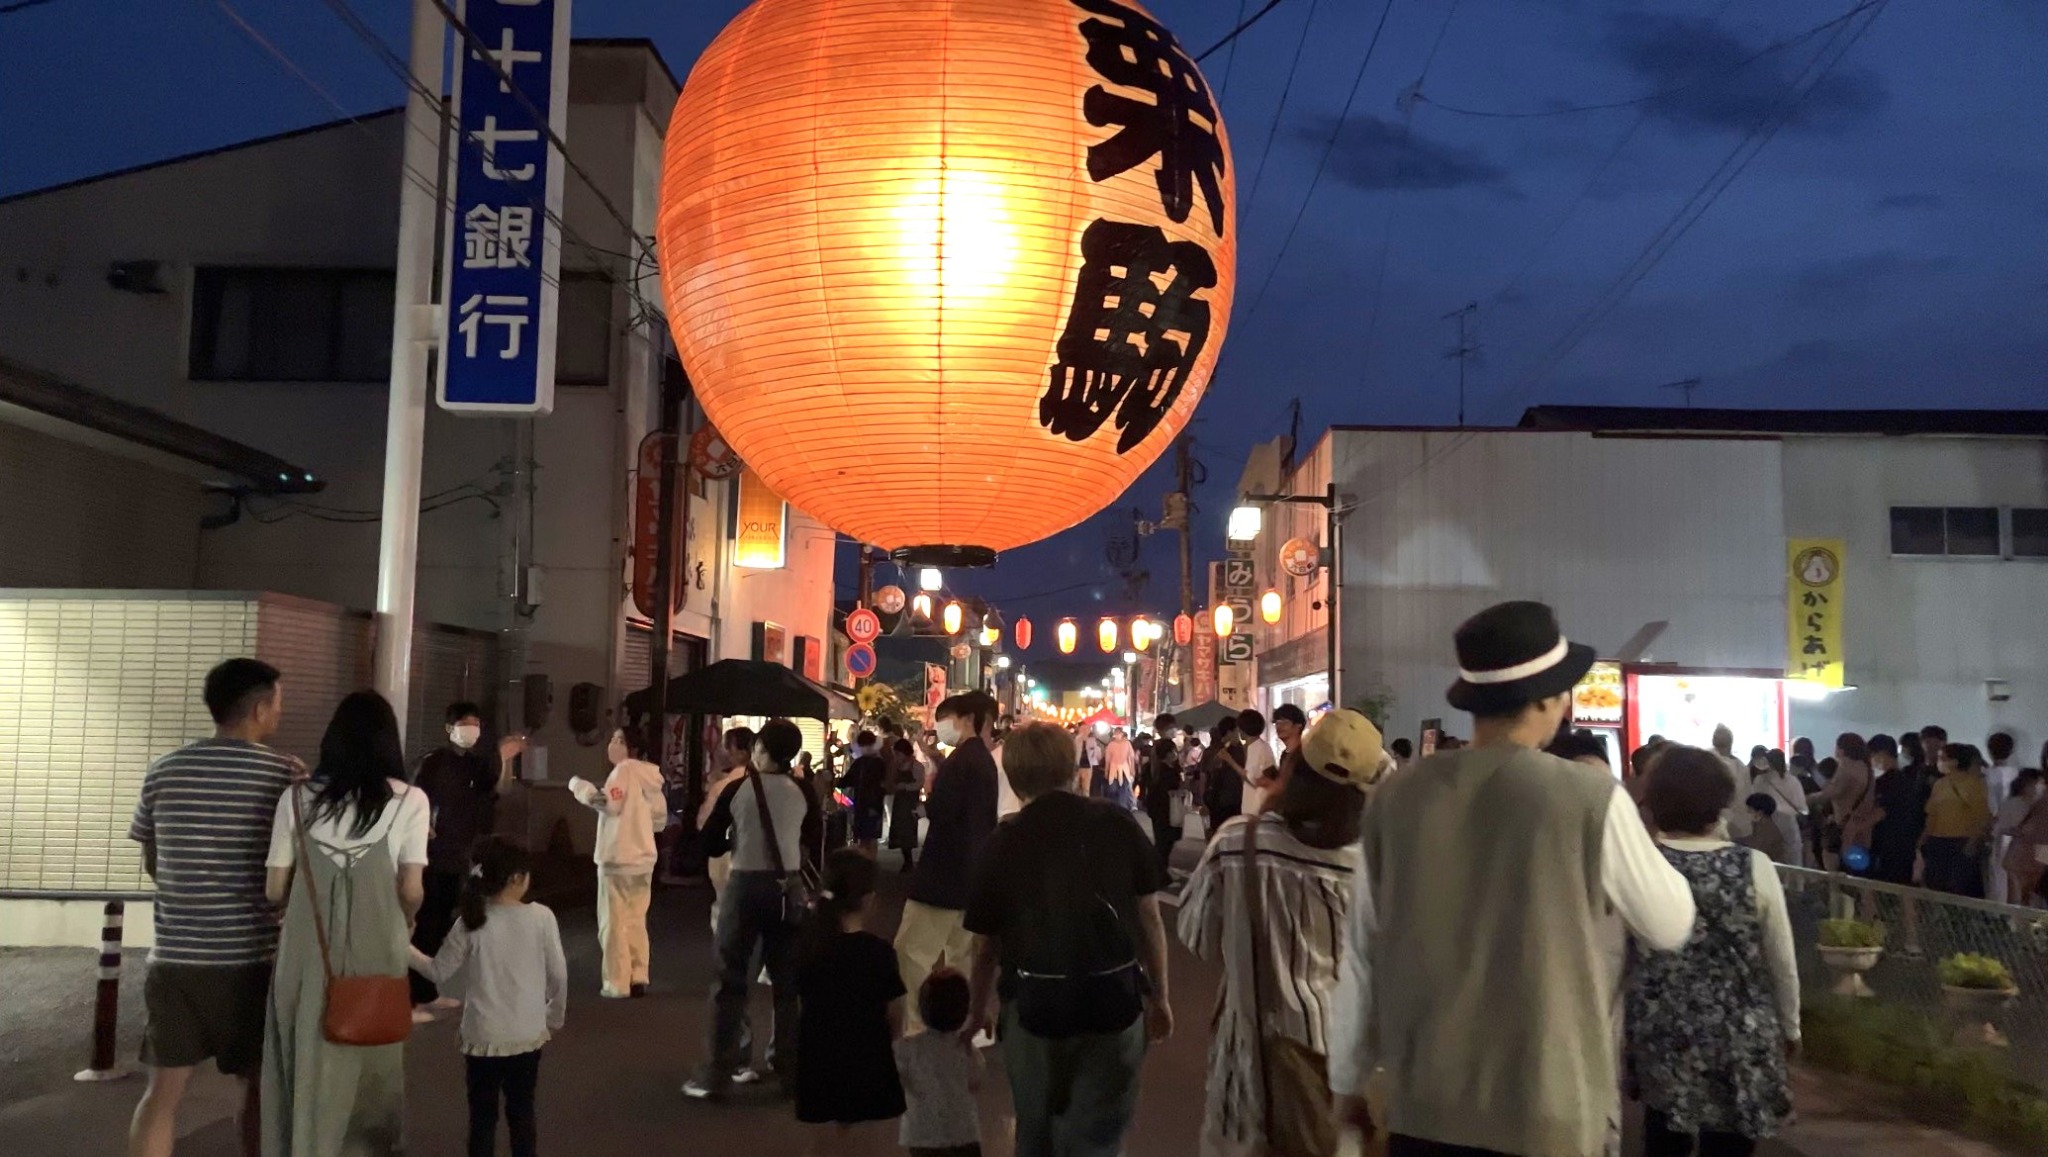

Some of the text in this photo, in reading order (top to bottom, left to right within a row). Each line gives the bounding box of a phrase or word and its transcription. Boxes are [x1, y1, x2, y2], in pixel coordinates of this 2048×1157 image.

[458, 0, 542, 360] 十七銀行
[739, 521, 780, 540] YOUR
[854, 619, 872, 634] 40
[1228, 562, 1254, 659] みうら
[1801, 590, 1831, 677] からあげ
